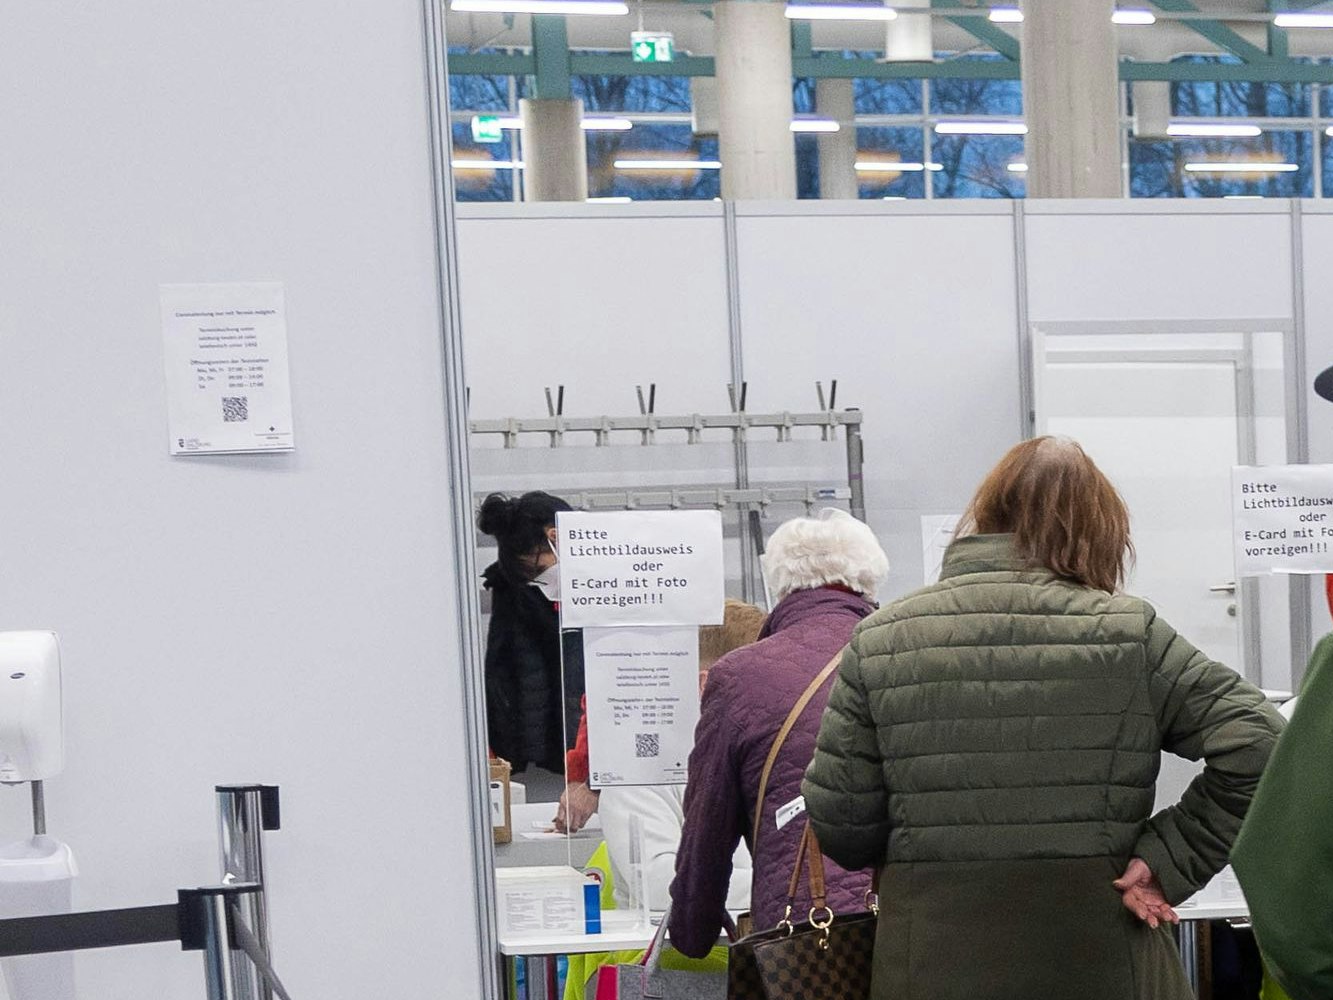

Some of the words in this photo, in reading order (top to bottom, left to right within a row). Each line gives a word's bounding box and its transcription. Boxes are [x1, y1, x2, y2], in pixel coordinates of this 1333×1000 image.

[1242, 482, 1277, 494] Bitte
[1299, 512, 1327, 522] oder
[569, 529, 608, 540] Bitte
[1244, 529, 1287, 541] E-Card
[1293, 527, 1314, 538] mit
[570, 543, 693, 557] Lichtbildausweis
[1245, 542, 1328, 557] vorzeigen!!!
[632, 561, 664, 572] oder
[571, 578, 618, 589] E-Card
[625, 576, 648, 588] mit
[657, 577, 687, 587] Foto
[571, 593, 663, 607] vorzeigen!!!
